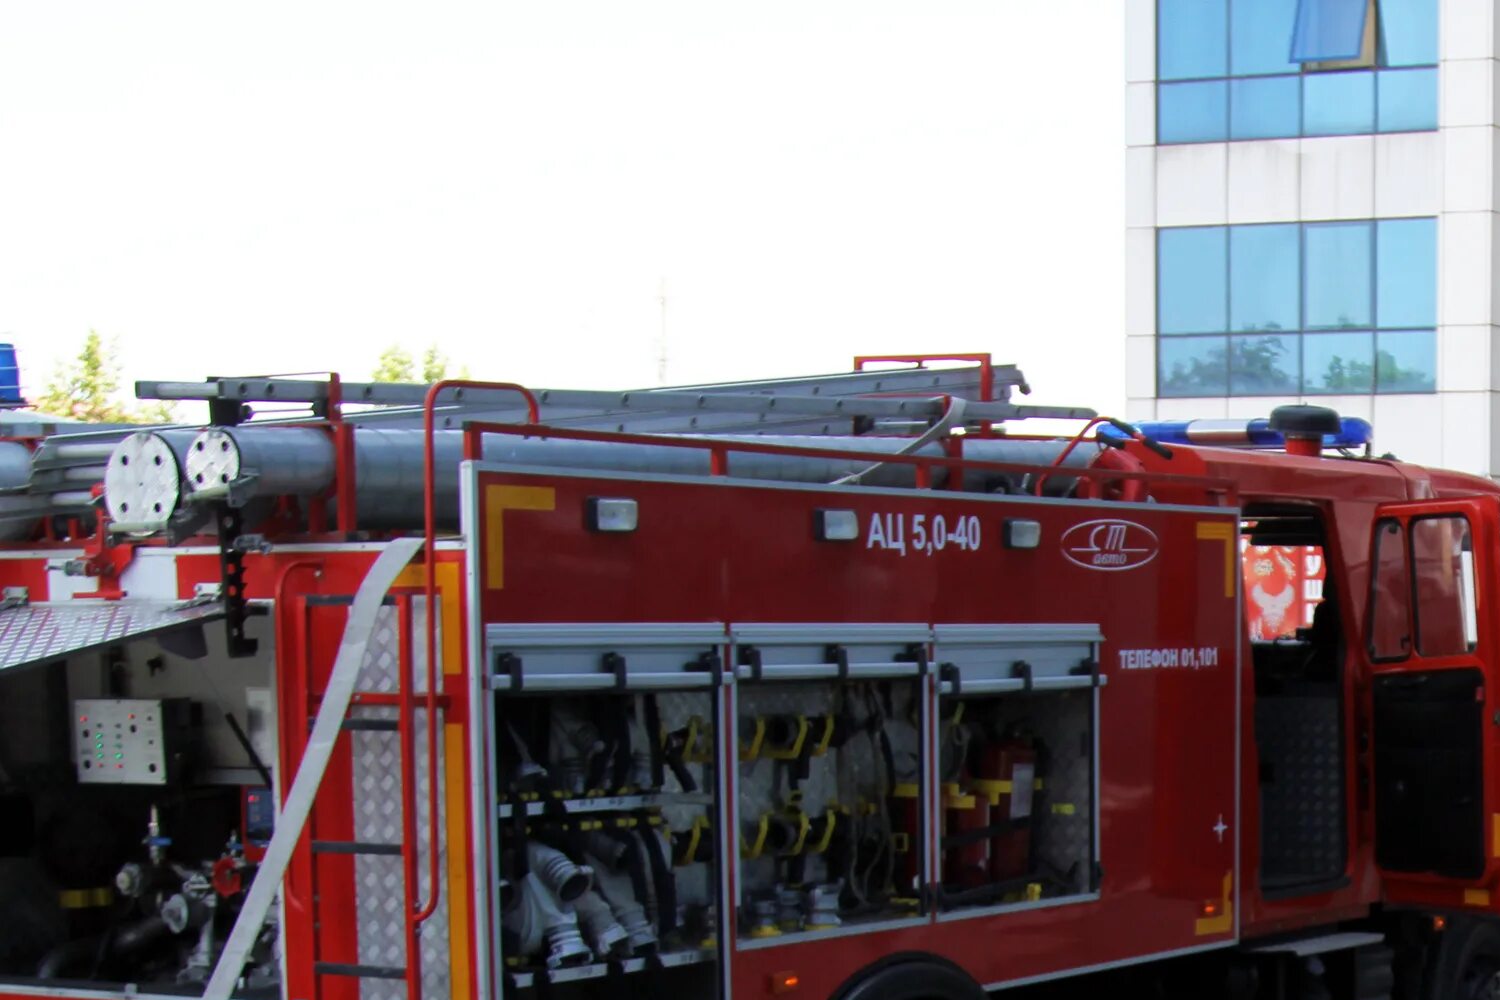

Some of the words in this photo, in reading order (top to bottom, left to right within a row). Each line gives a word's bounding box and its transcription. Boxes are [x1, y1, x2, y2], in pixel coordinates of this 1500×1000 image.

[866, 512, 906, 556] АЦ
[911, 514, 981, 556] 5,0-40
[1118, 648, 1179, 669] ТЕЛЕФОН
[1181, 646, 1218, 670] 01,101
